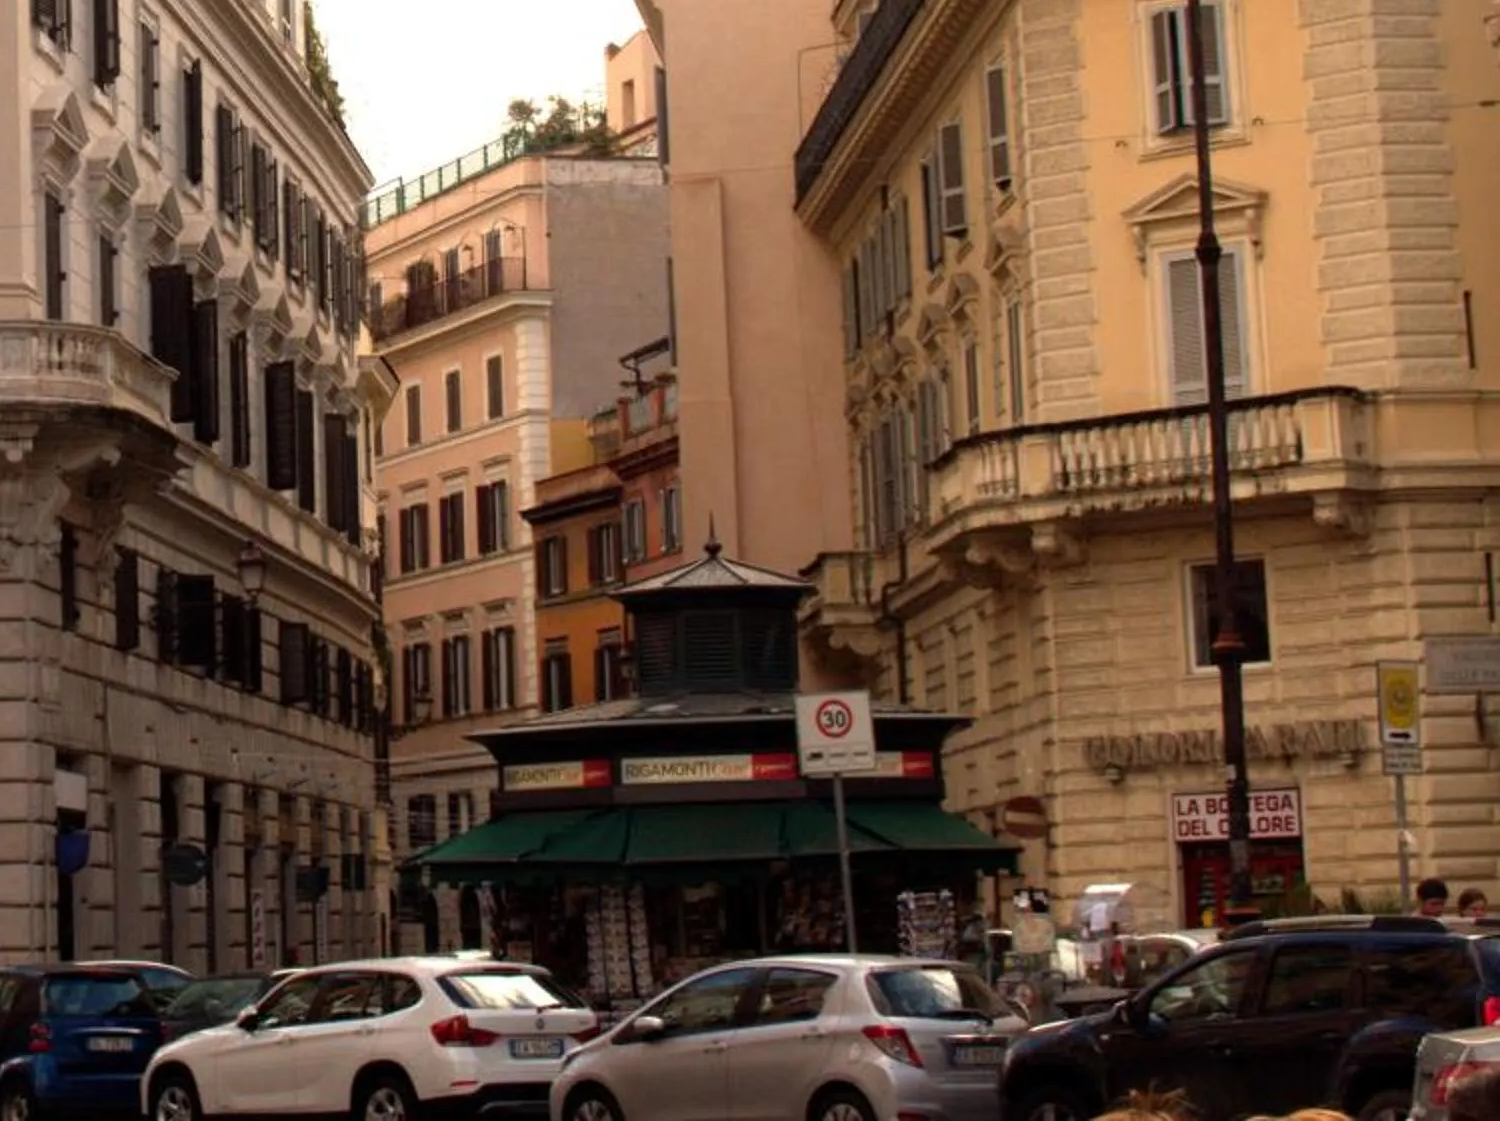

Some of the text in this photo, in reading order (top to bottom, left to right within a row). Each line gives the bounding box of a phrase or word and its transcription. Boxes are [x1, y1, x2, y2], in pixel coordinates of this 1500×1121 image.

[823, 710, 846, 728] 30
[1243, 719, 1366, 759] ARATI
[1177, 794, 1293, 815] LA BOEGA
[1177, 815, 1296, 836] DEL CORE
